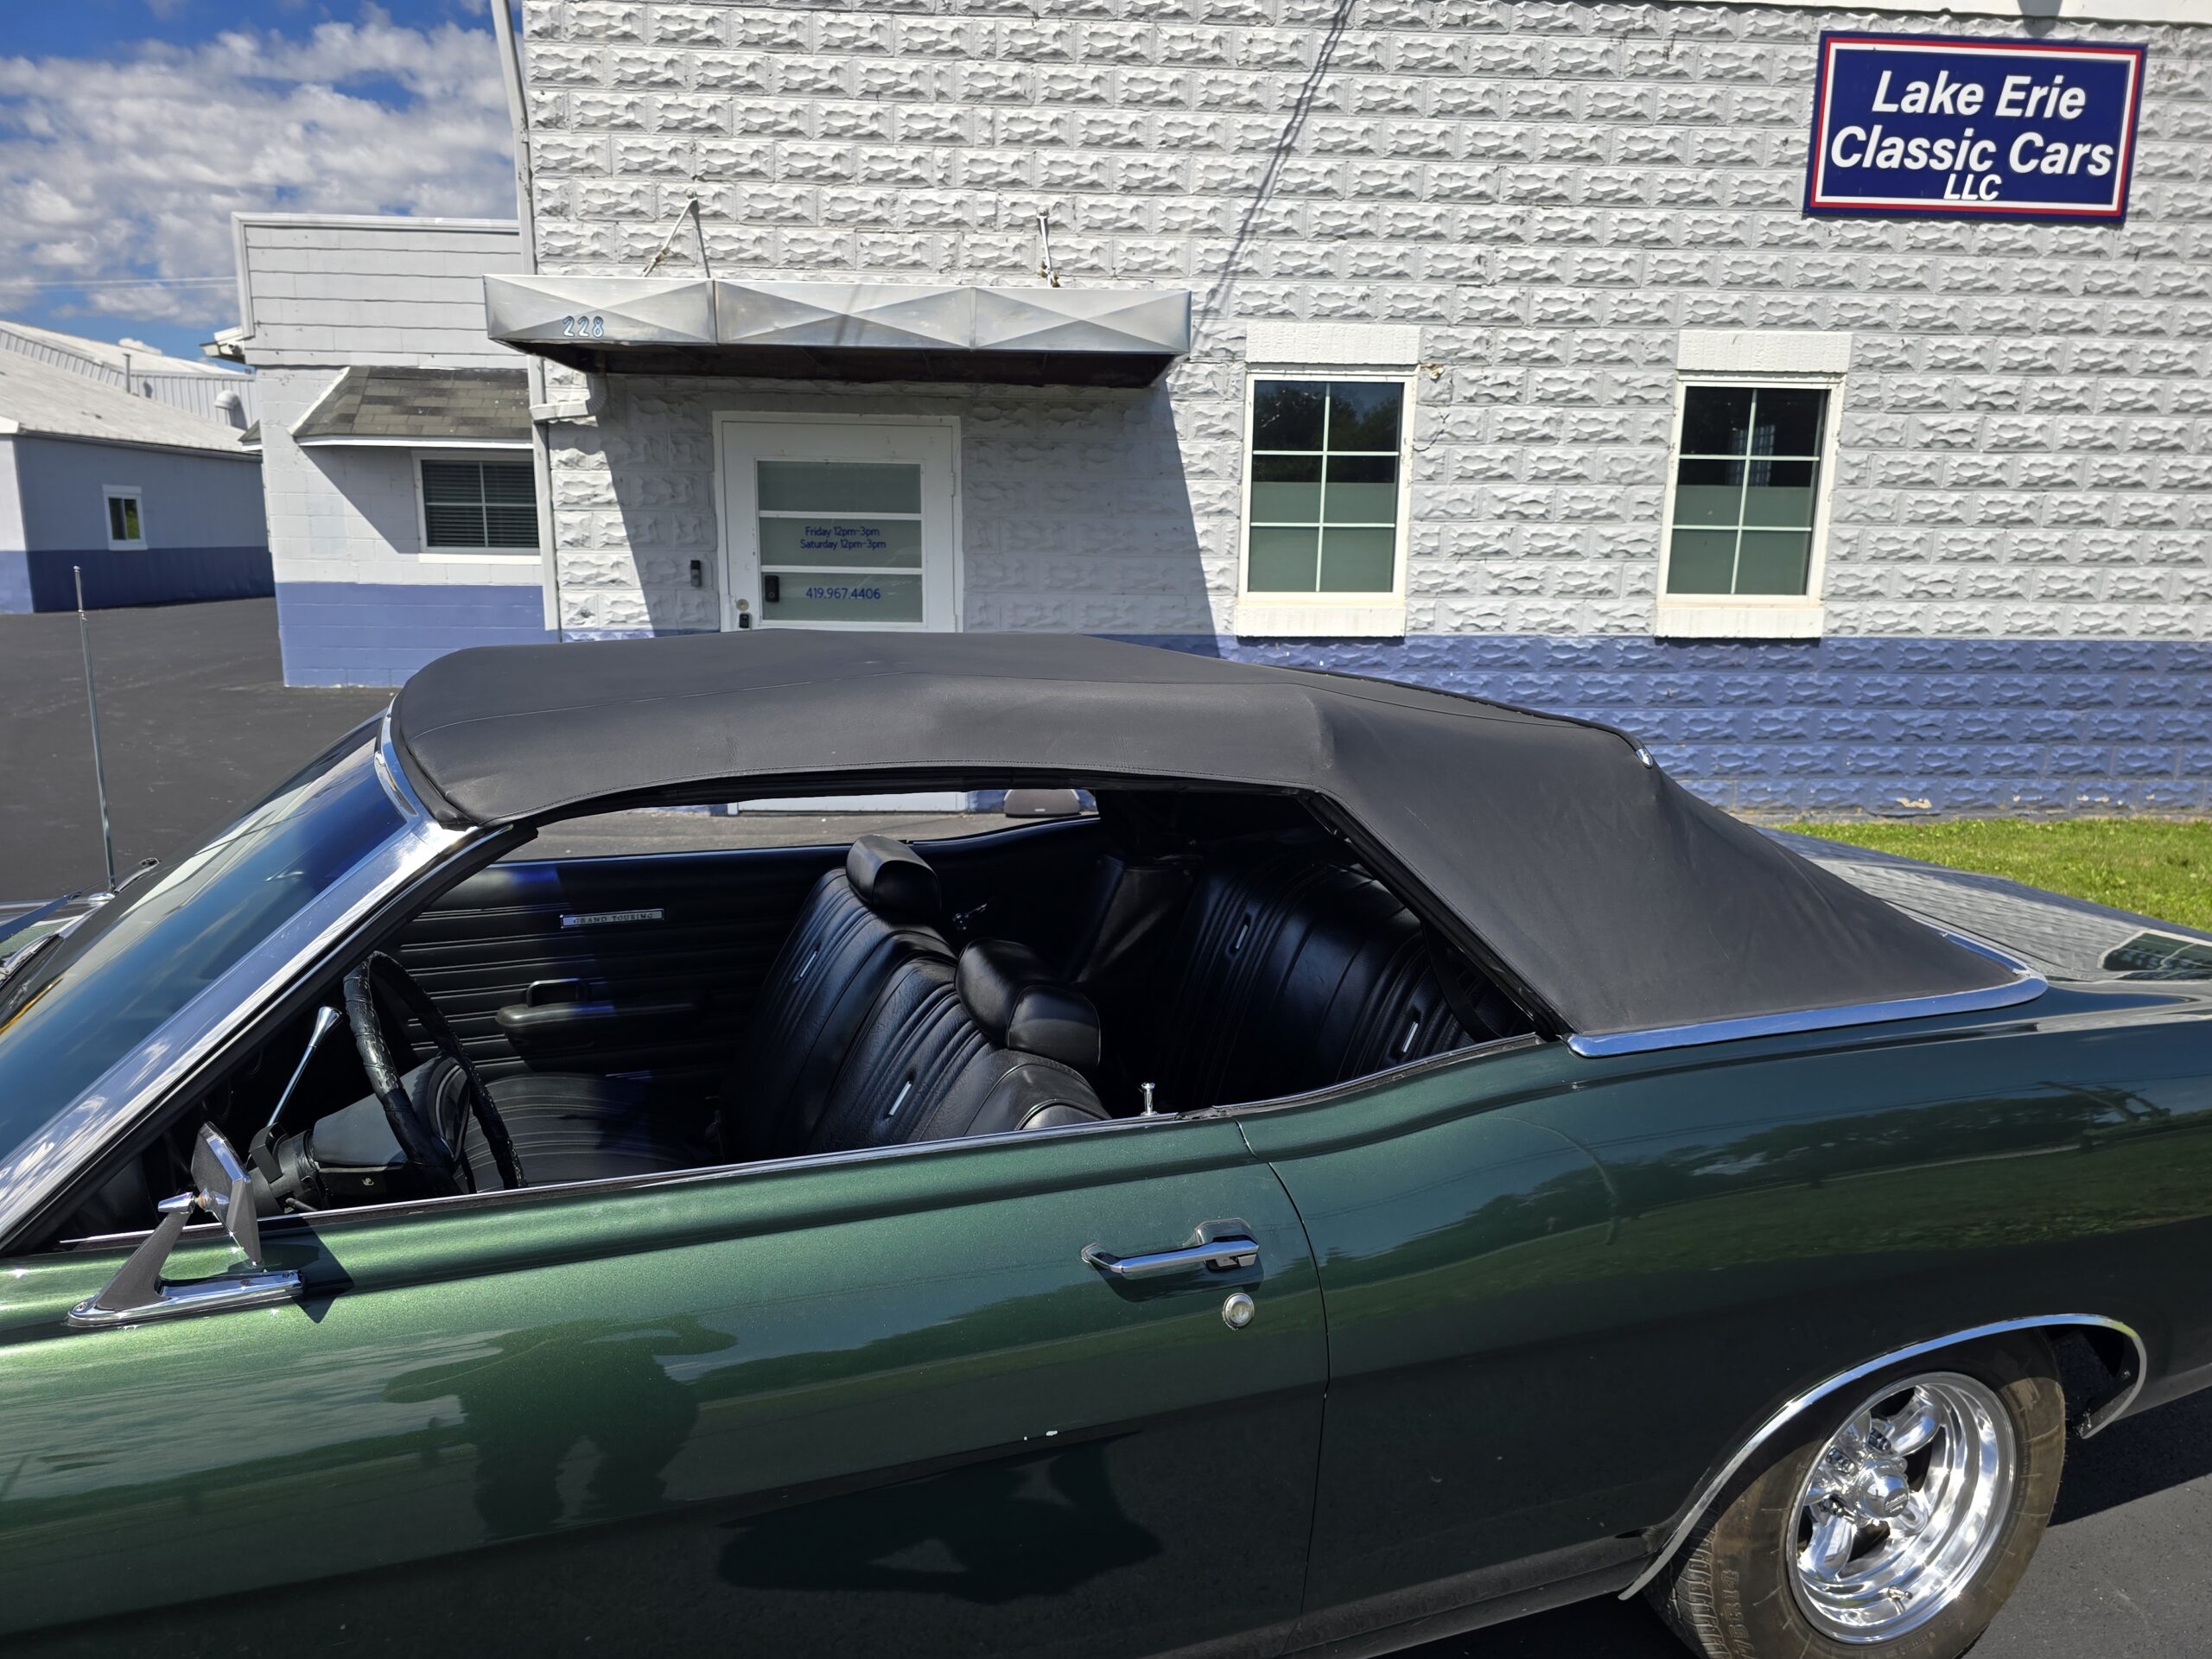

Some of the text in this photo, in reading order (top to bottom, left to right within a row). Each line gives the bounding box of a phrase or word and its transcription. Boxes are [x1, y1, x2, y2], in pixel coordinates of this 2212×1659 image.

[1872, 70, 2087, 119] Lake Erie
[1830, 124, 2113, 176] Classic Cars
[1943, 173, 2002, 200] LLC
[563, 315, 604, 338] 228
[804, 525, 831, 538] Friday
[800, 539, 838, 551] Saturday
[805, 587, 881, 600] 419.967.4406
[573, 912, 653, 925] GRAND TOURING
